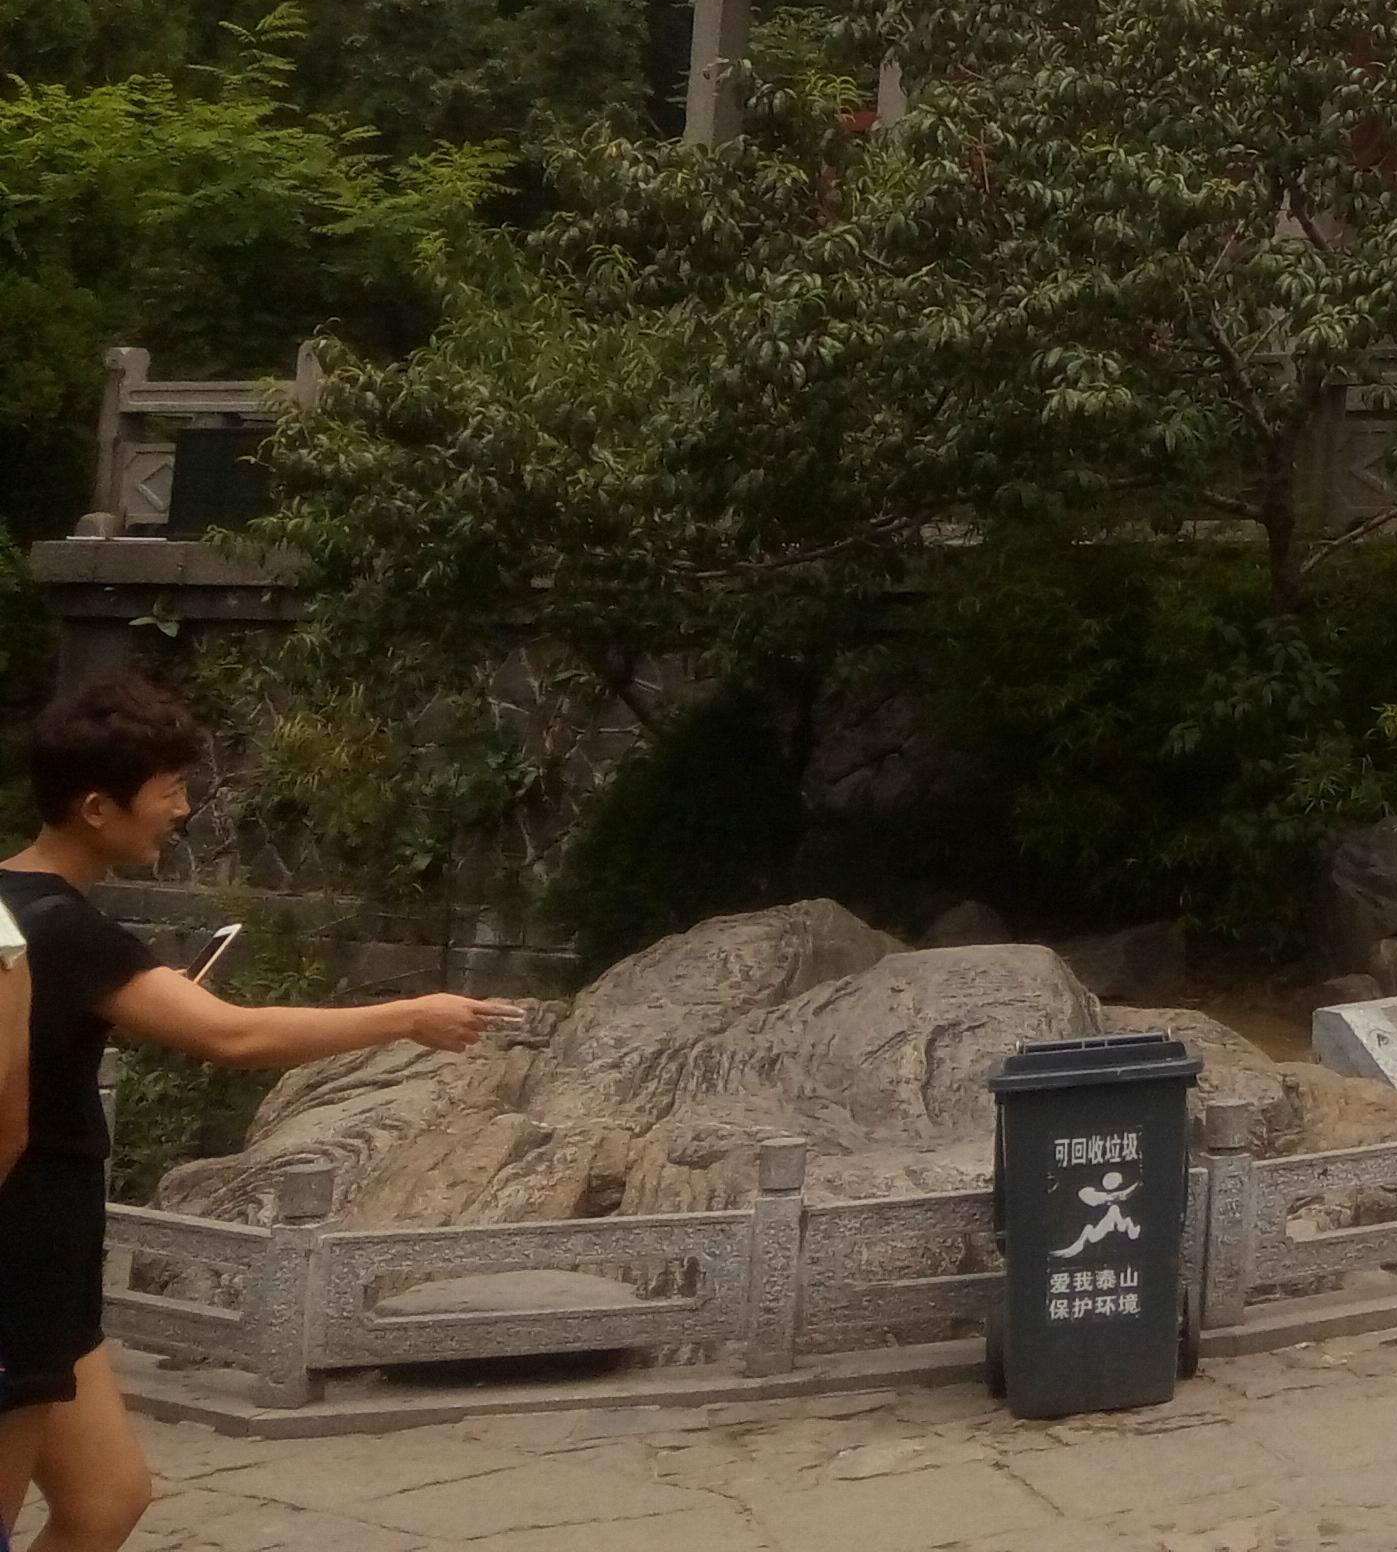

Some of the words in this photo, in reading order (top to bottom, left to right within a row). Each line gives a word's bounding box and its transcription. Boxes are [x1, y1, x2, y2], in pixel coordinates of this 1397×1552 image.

[1054, 1132, 1139, 1167] 可回收垃圾
[1049, 1266, 1139, 1294] 爱我泰山
[1049, 1294, 1141, 1320] 保护环境
